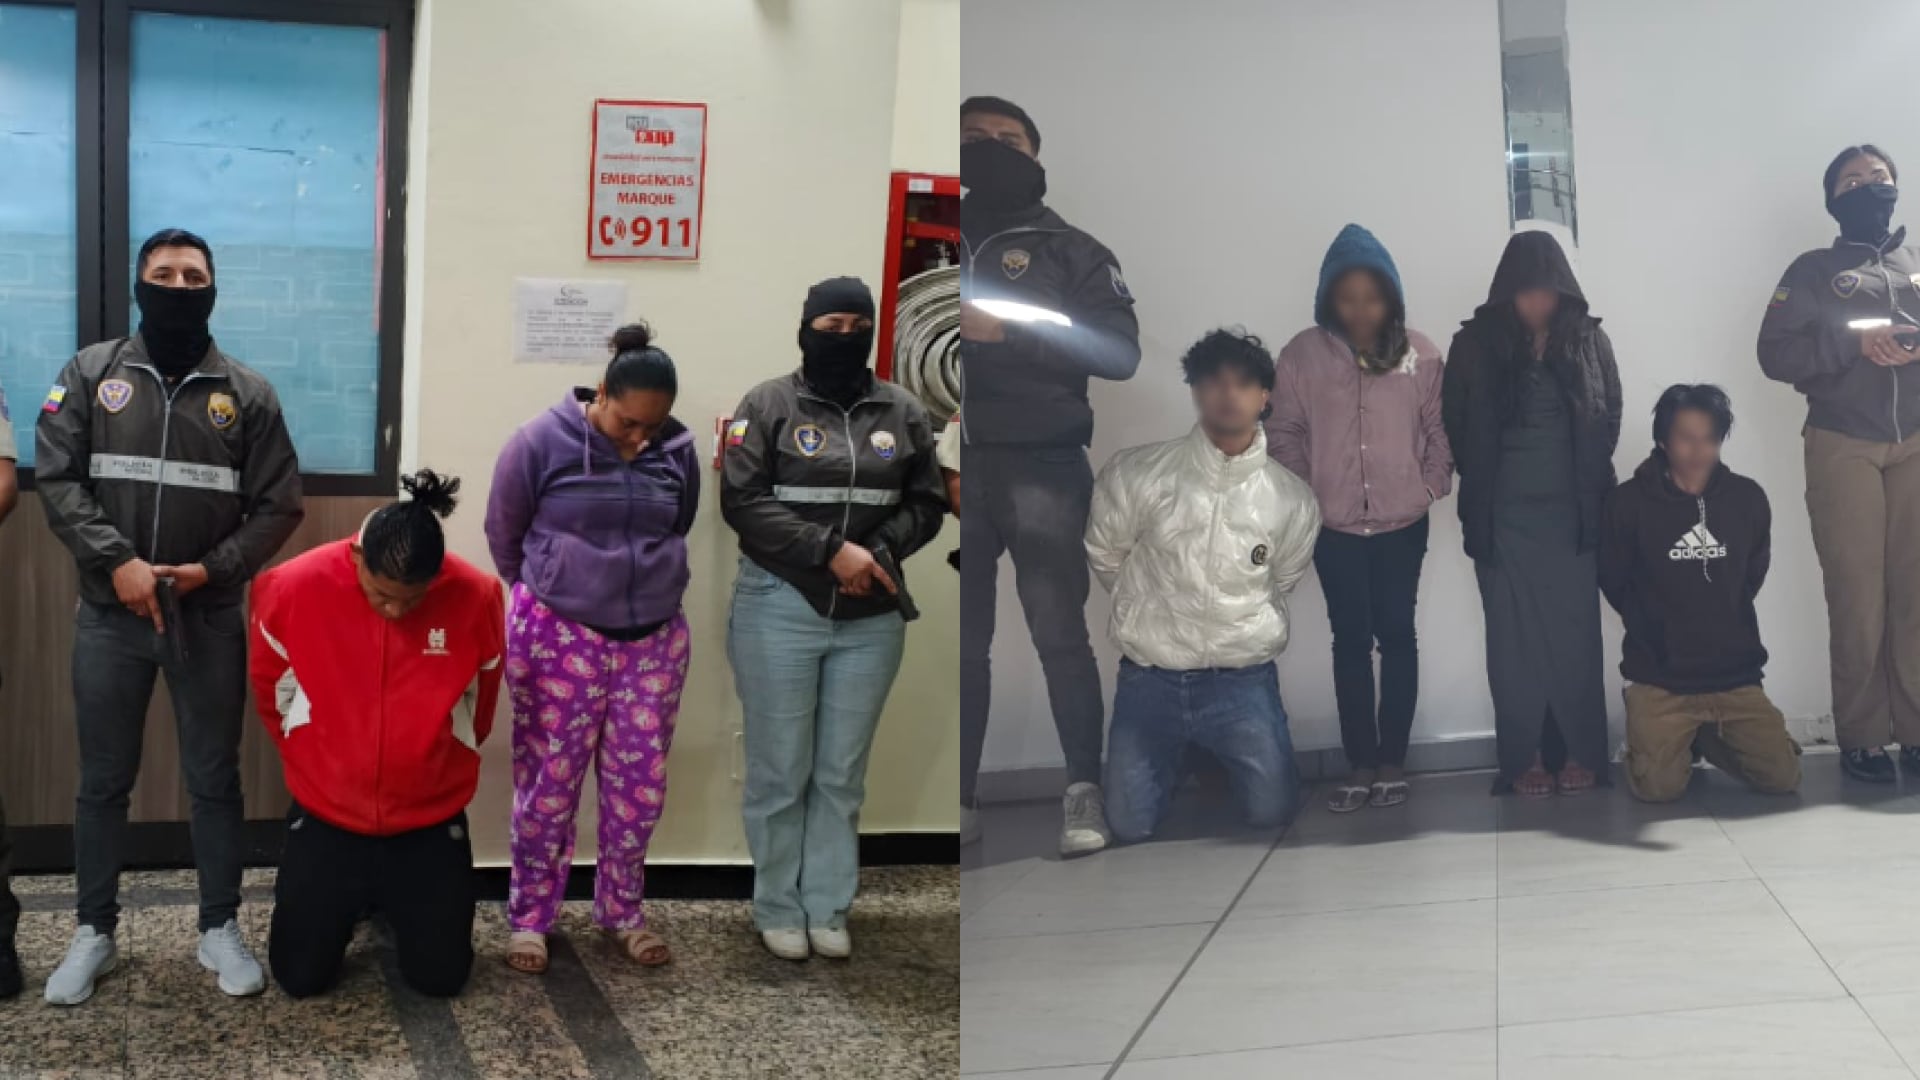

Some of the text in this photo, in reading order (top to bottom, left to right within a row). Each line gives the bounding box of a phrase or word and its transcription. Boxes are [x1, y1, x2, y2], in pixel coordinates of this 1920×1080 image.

[600, 172, 694, 187] EMERGENCIAS
[617, 192, 676, 205] MARQUE
[631, 216, 691, 247] 911
